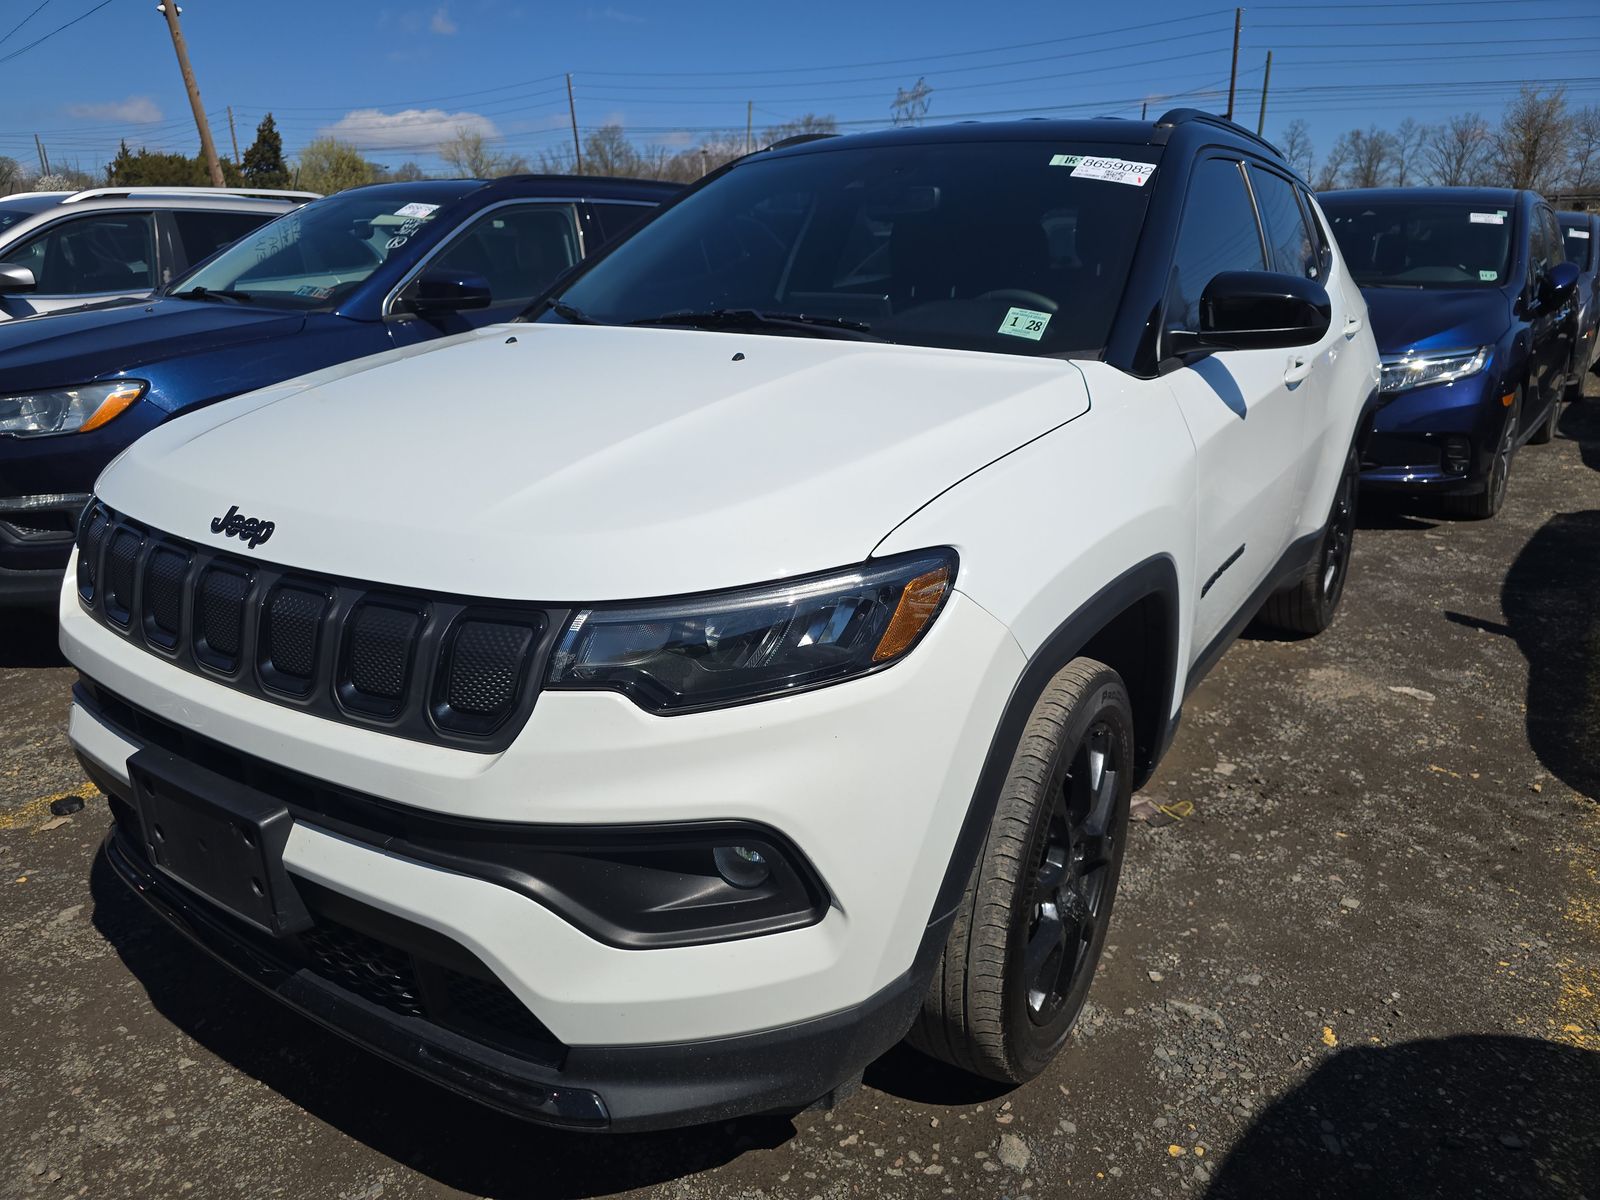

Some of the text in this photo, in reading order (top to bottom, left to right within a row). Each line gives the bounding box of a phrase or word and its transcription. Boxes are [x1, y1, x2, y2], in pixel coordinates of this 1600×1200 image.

[1083, 158, 1153, 174] 8659082
[1010, 316, 1019, 327] 1
[1025, 319, 1043, 332] 28
[210, 505, 275, 549] Jeep
